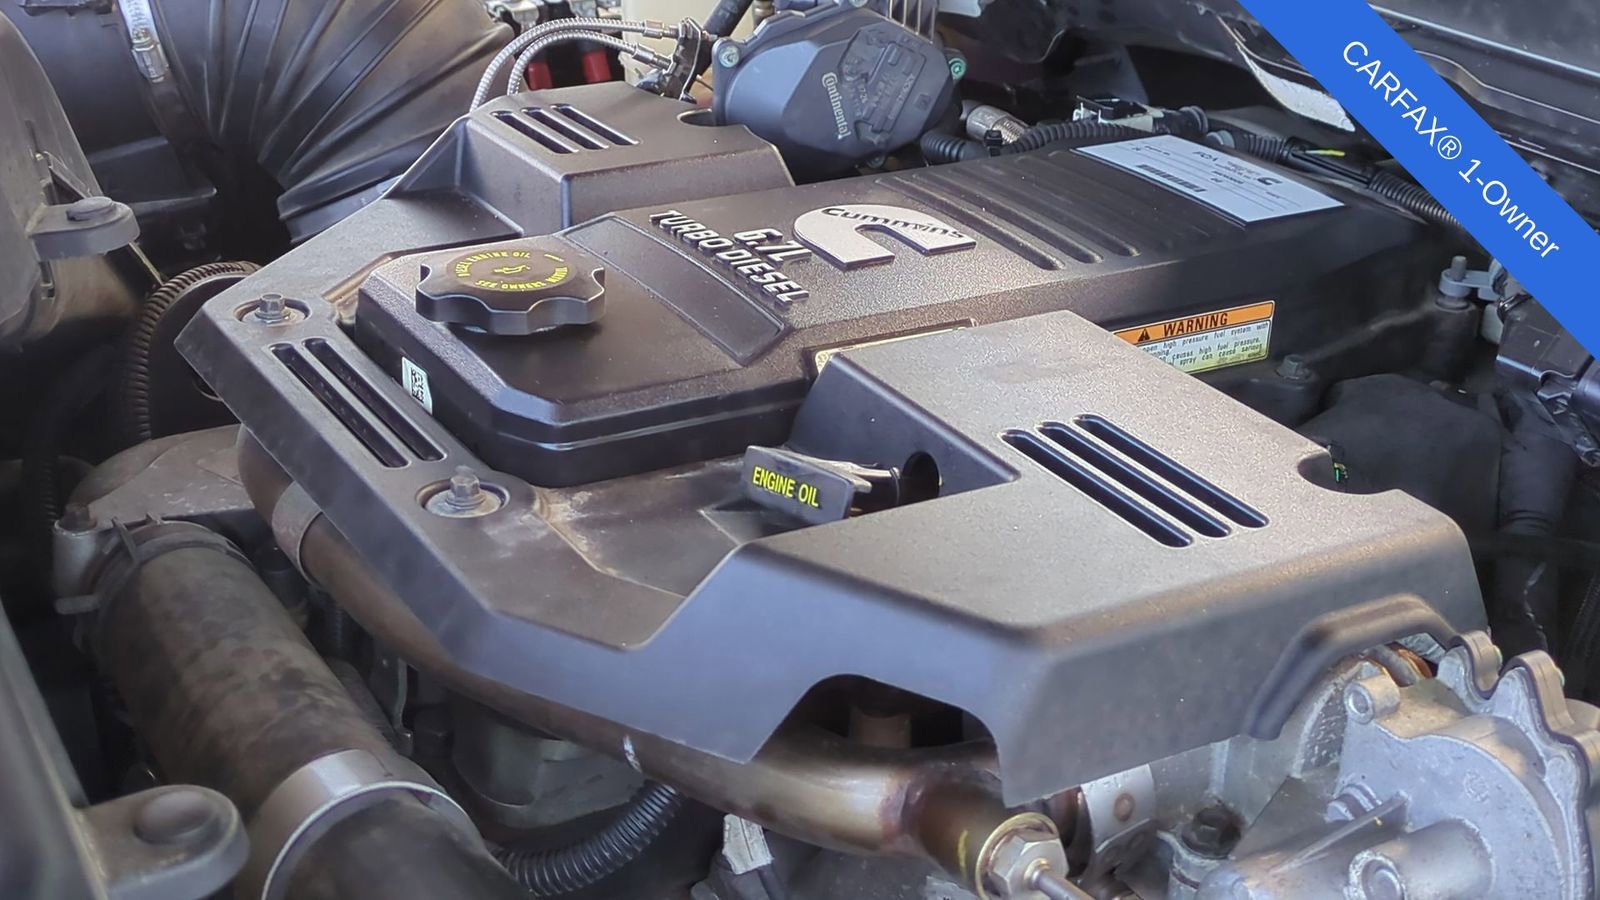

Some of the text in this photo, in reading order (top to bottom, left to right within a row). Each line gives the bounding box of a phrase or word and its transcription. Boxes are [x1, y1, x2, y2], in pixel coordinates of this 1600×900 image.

[821, 71, 852, 140] Continental
[821, 207, 964, 239] Cummins
[648, 209, 810, 306] TURBO DIESEL
[733, 228, 812, 263] 6.7L
[475, 280, 498, 288] SEE
[1163, 313, 1228, 337] WARNING
[1163, 341, 1176, 349] high
[1182, 335, 1209, 347] pressure
[1214, 330, 1226, 340] fuel
[1231, 327, 1251, 336] system
[1180, 356, 1197, 367] spray
[1202, 353, 1213, 361] can
[1218, 350, 1236, 358] cause
[1199, 345, 1212, 355] high
[1217, 341, 1229, 351] fuel
[752, 466, 819, 507] ENGINE OIL
